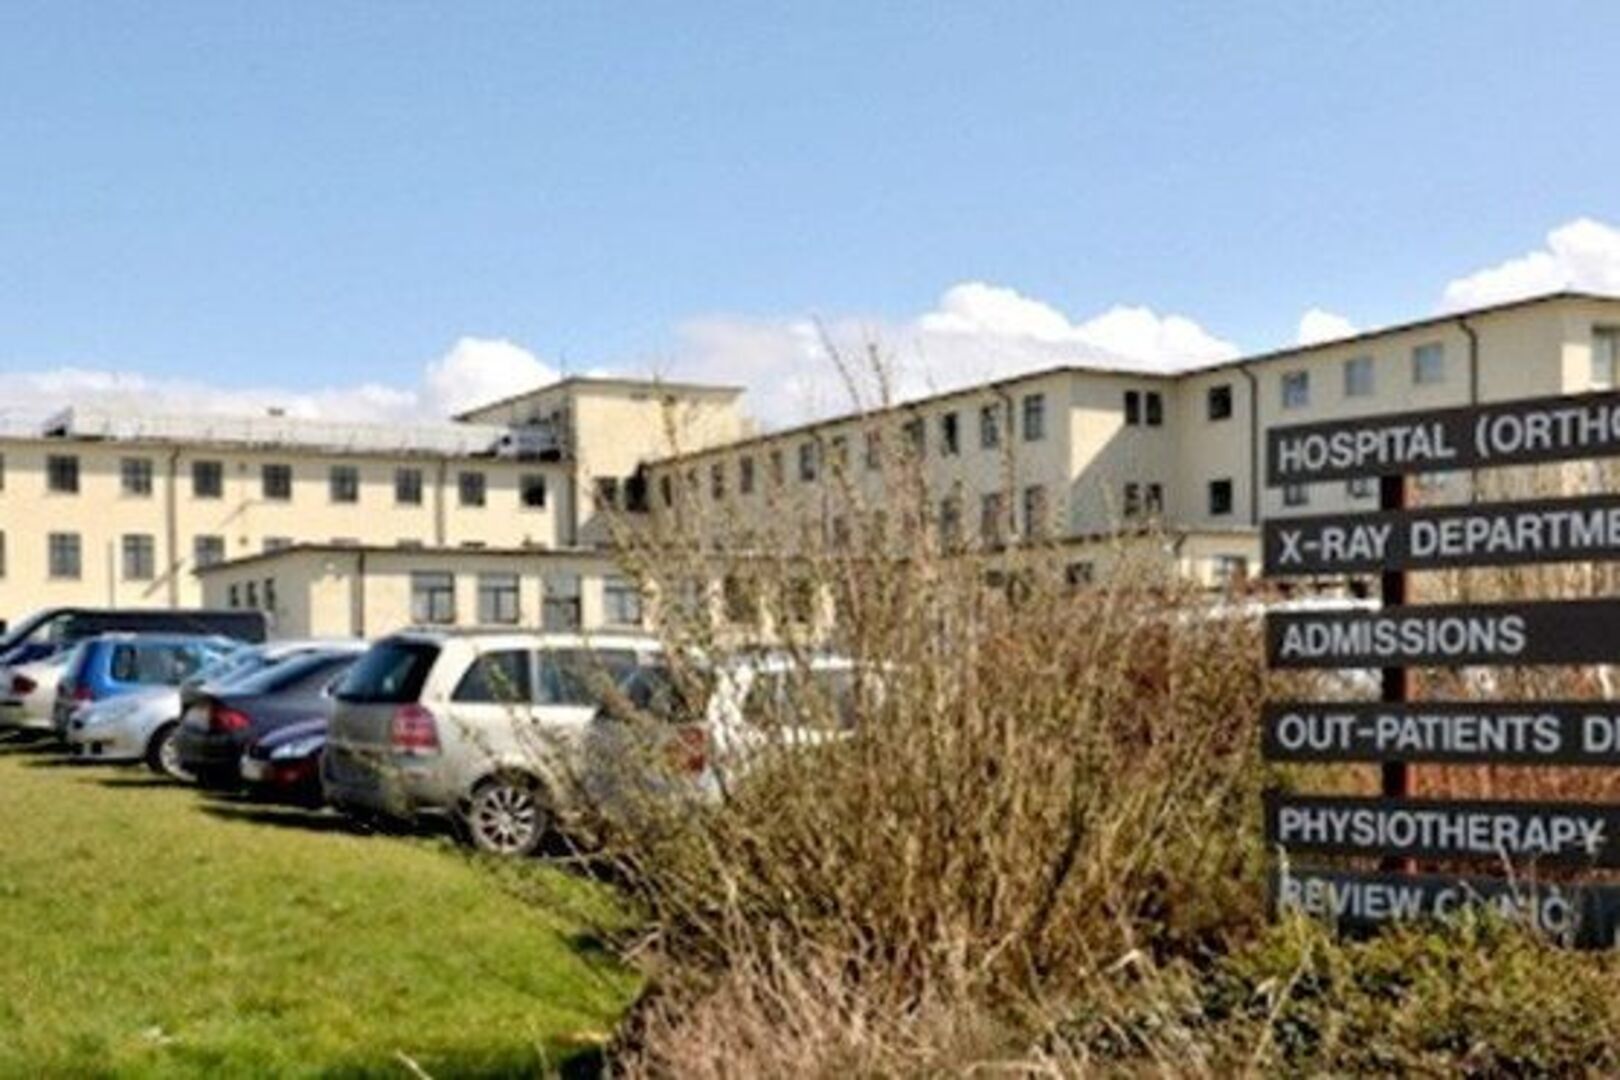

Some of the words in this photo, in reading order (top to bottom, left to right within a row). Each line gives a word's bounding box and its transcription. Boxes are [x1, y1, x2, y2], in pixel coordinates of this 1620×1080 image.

[1279, 424, 1455, 472] HOSPITAL
[1279, 524, 1391, 564] X-RAY
[1411, 510, 1620, 556] DEPARTME
[1281, 616, 1526, 659] ADMISSIONS
[1277, 714, 1561, 752] OUT-PATIENTS
[1584, 716, 1620, 752] D
[1279, 808, 1605, 856] PHYSIOTHERAPY
[1279, 876, 1423, 920] REVIEW
